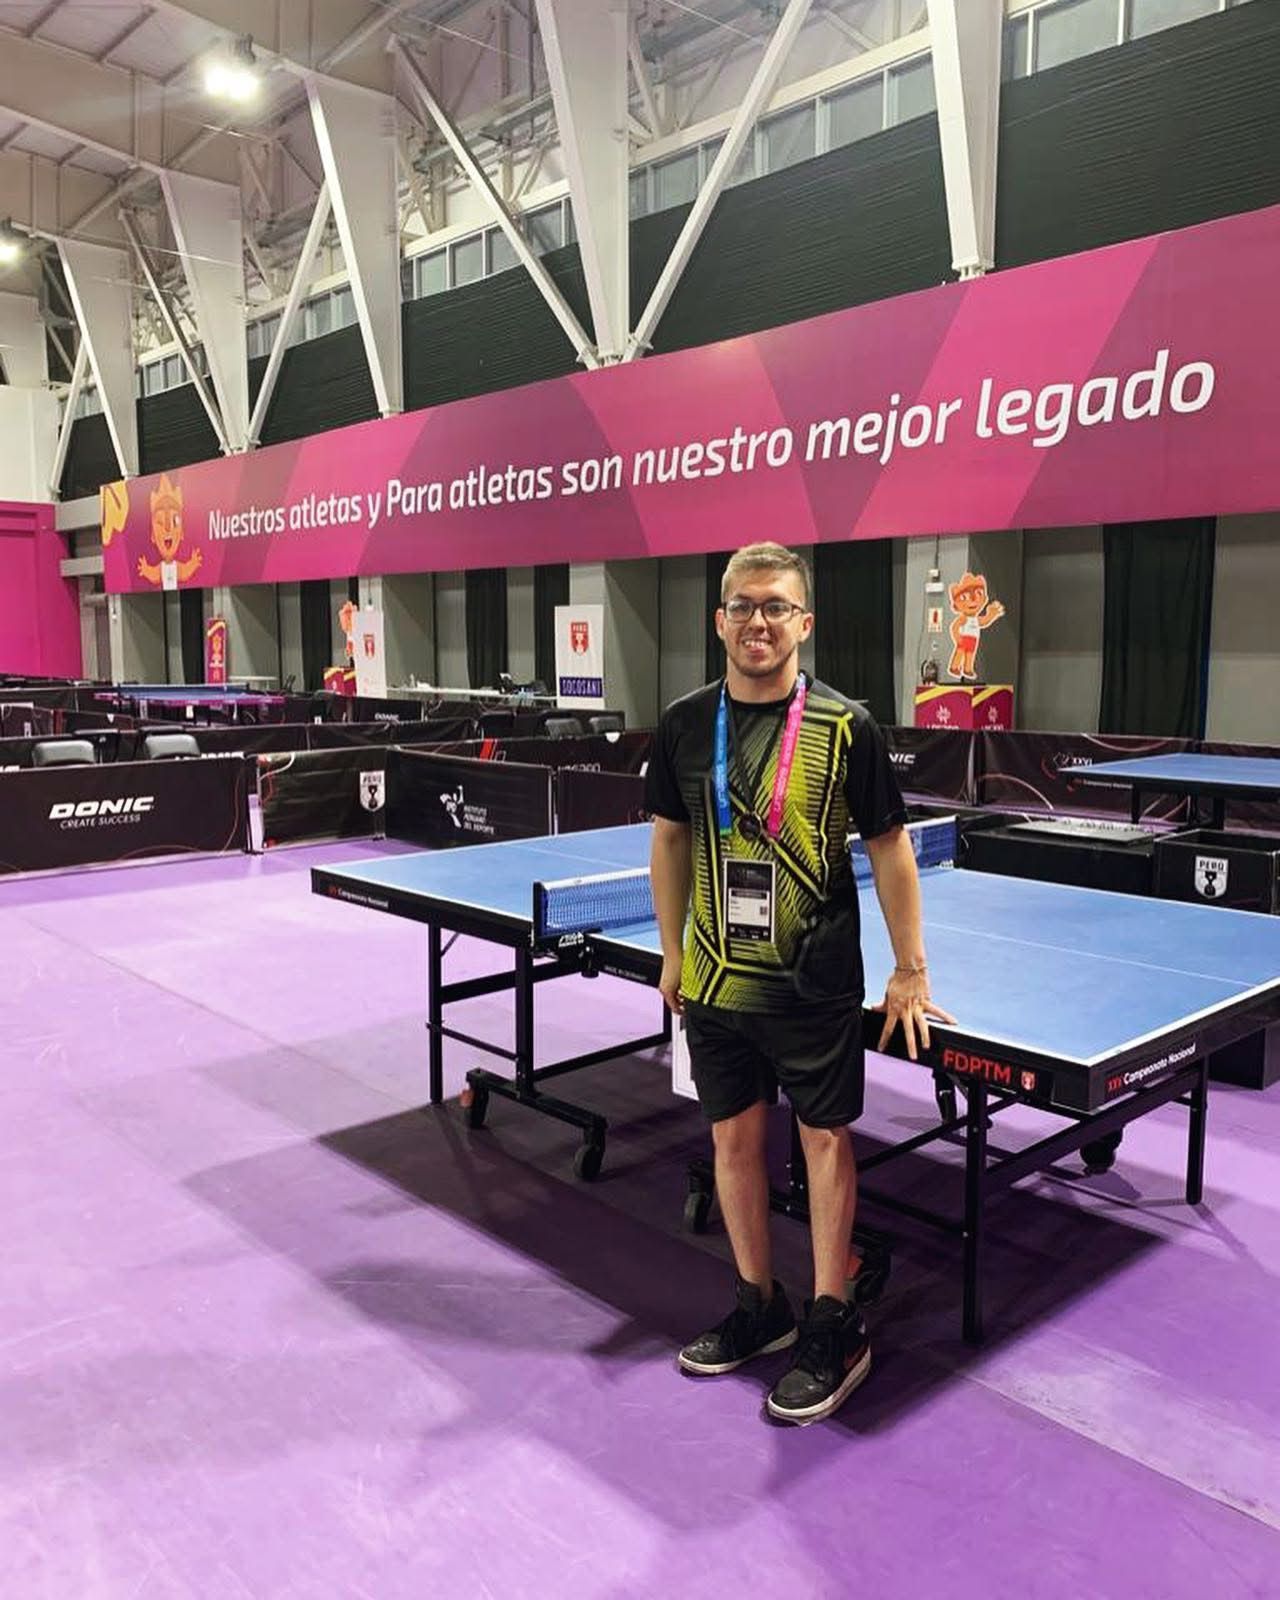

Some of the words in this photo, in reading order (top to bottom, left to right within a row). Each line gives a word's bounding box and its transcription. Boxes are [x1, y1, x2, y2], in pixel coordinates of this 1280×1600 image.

[208, 506, 286, 540] Nuestros
[289, 493, 362, 530] atletas
[367, 492, 382, 529] y
[386, 479, 443, 517] Para
[450, 465, 553, 509] atletas
[561, 454, 623, 496] son
[632, 426, 794, 486] nuestro
[805, 393, 962, 465] mejor
[976, 349, 1215, 448] legado
[48, 796, 155, 820] DONIC
[60, 818, 96, 830] CREATE
[98, 813, 141, 827] SUCCESS
[943, 1049, 1012, 1084] FDPTM
